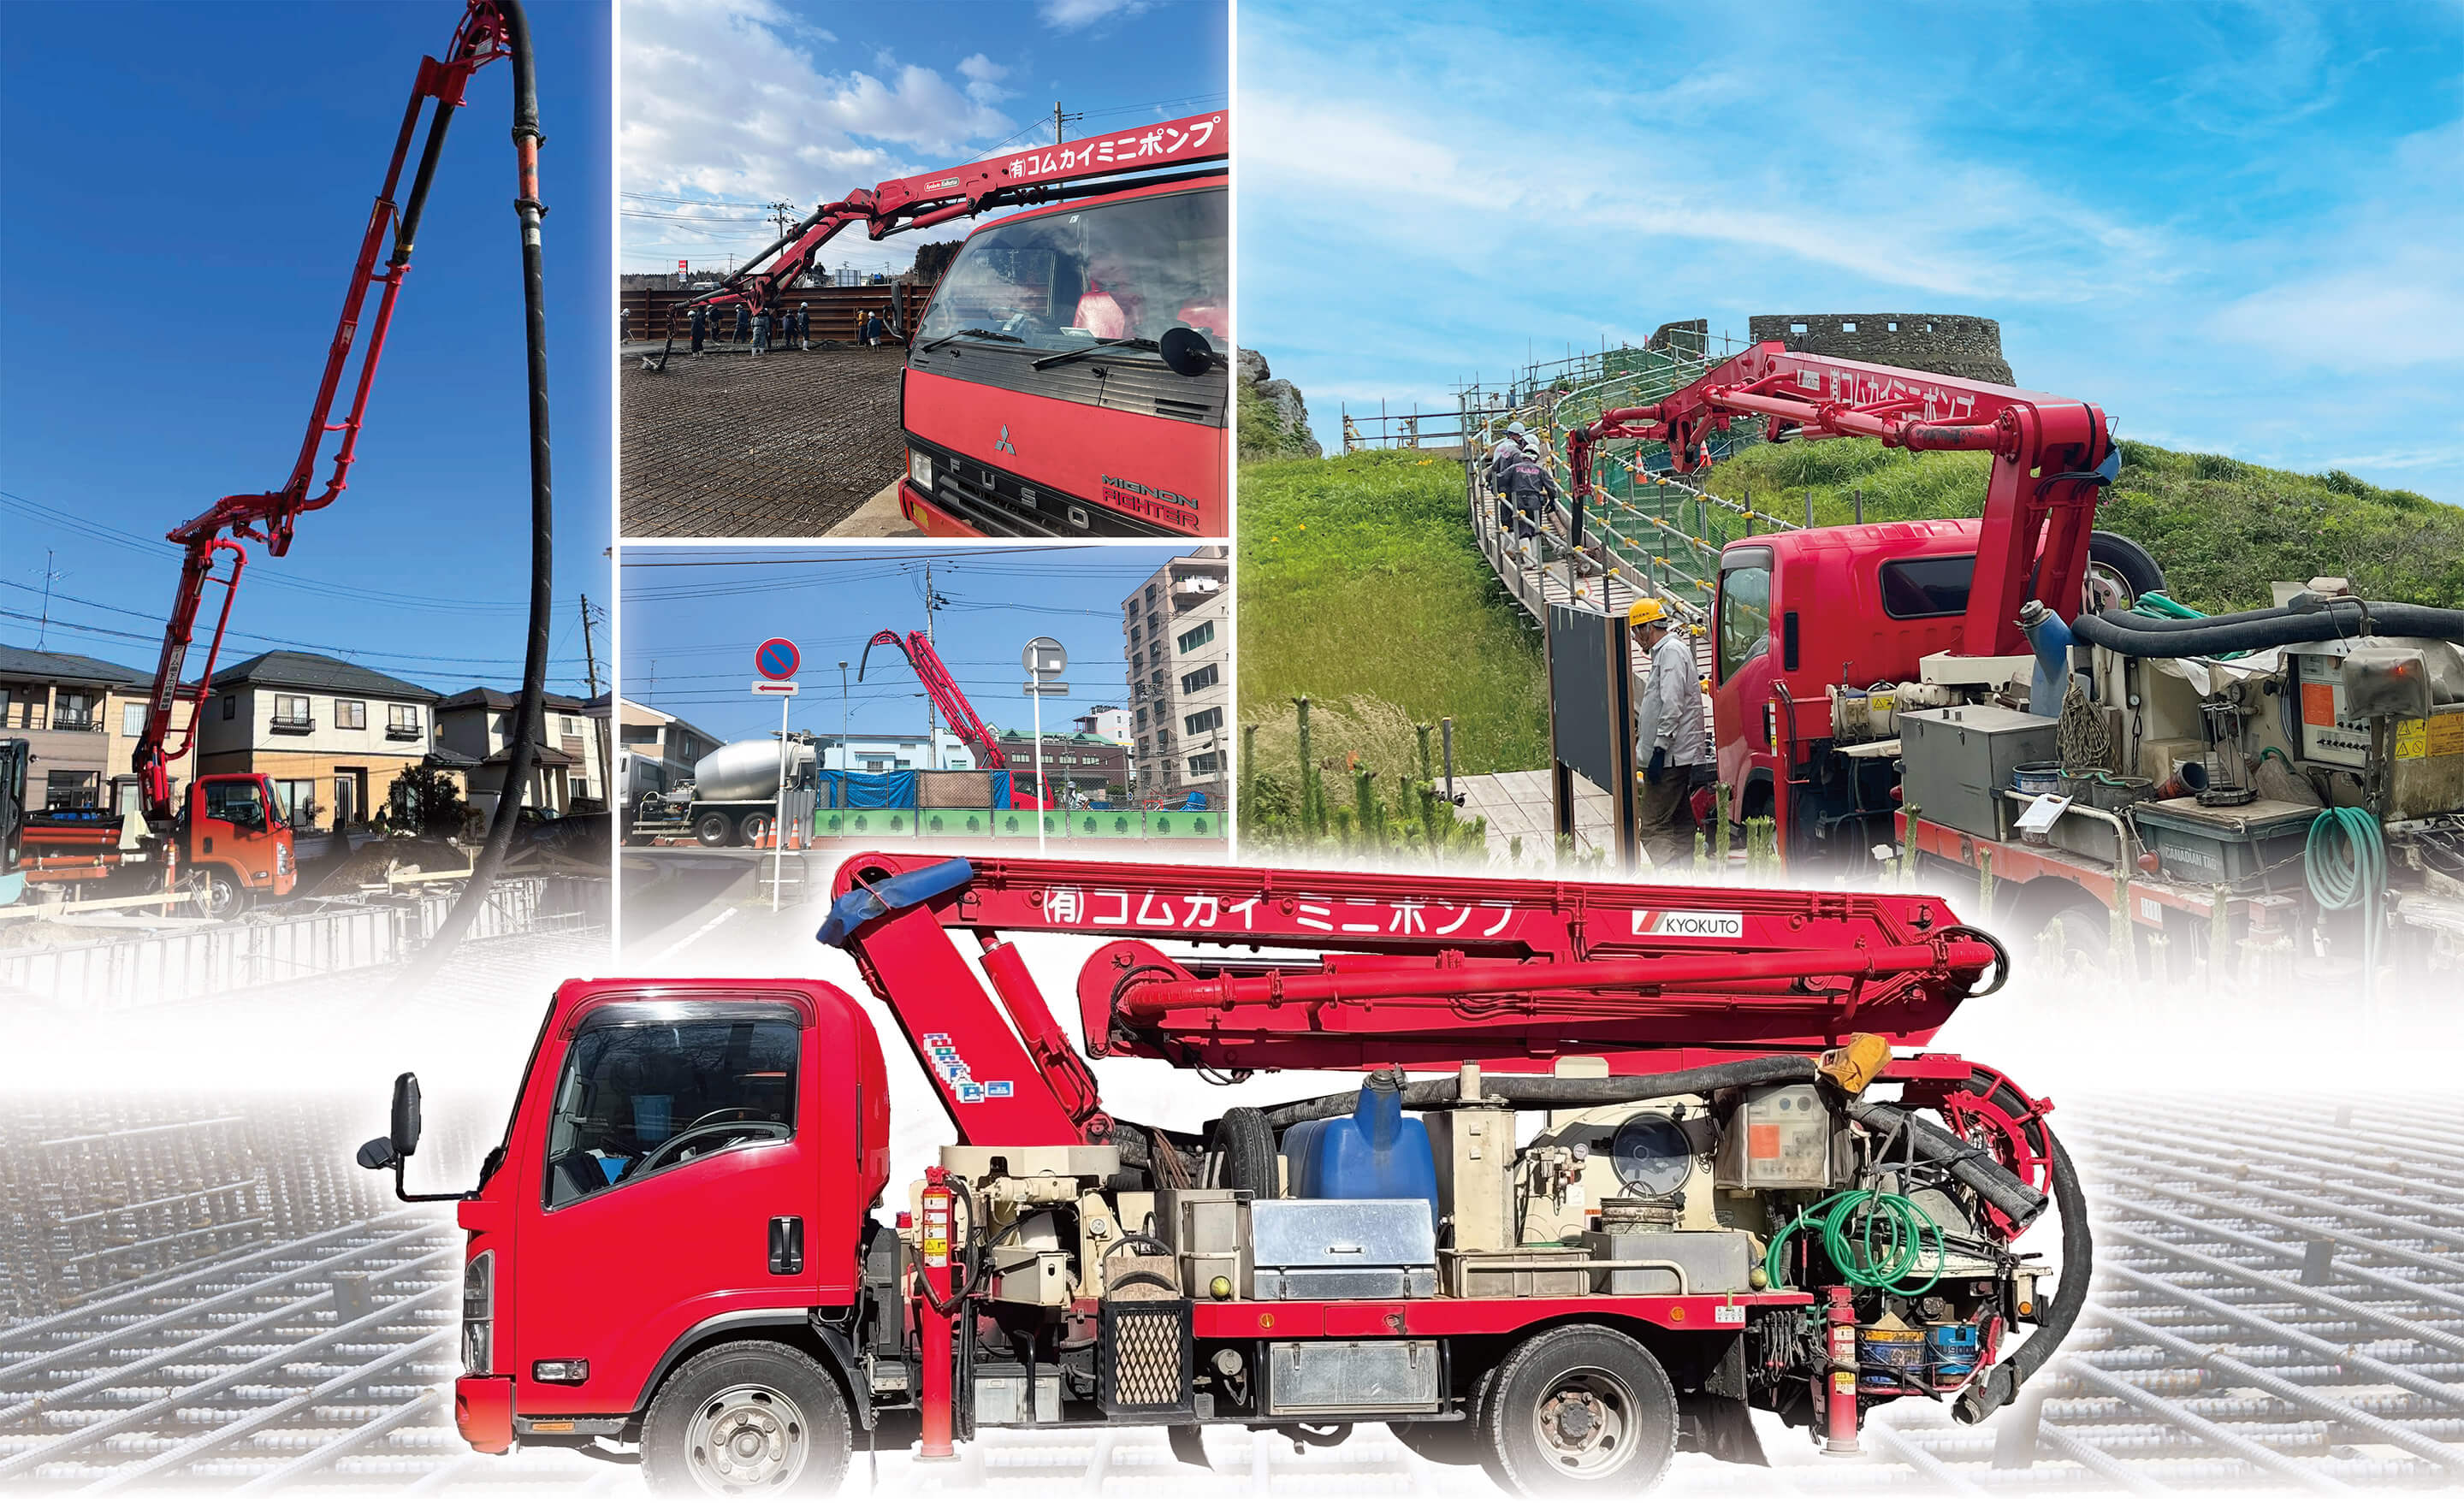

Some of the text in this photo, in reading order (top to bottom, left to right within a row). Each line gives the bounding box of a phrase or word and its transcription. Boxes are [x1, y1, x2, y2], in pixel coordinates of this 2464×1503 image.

[950, 458, 1089, 530] FUSO
[1101, 474, 1199, 510] MIGNON
[1102, 487, 1199, 531] FIGHTER
[1667, 918, 1739, 934] KYOKUTO
